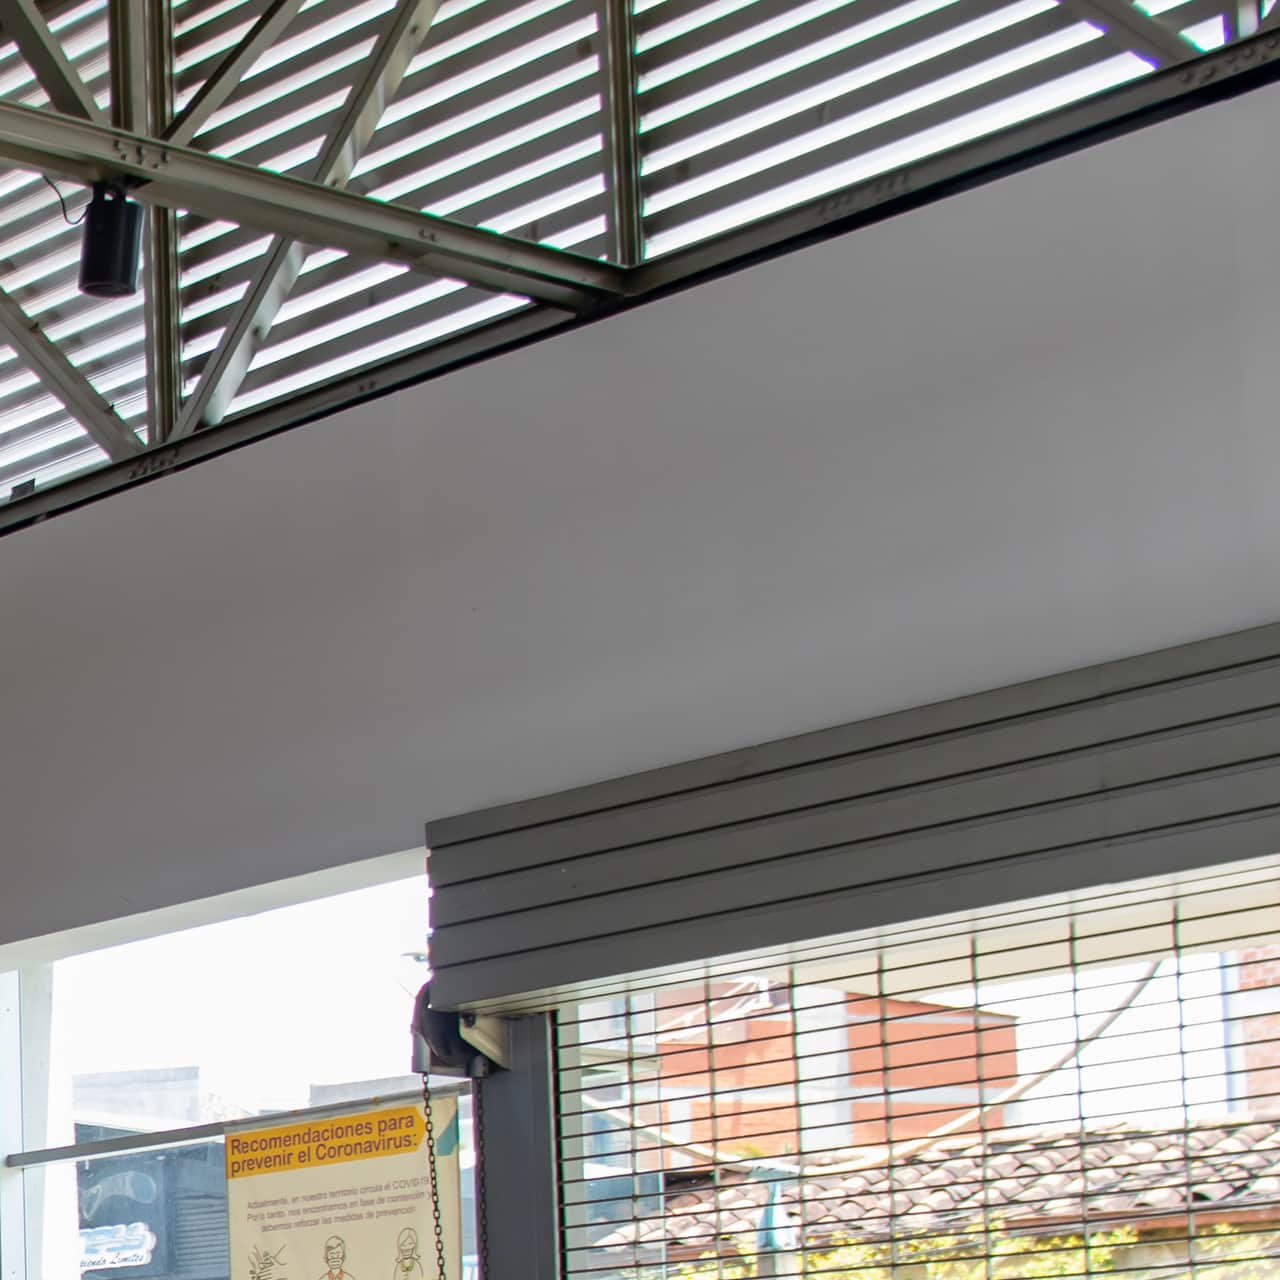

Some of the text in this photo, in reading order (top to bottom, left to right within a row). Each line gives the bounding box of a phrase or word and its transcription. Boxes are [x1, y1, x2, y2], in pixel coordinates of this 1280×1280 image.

[230, 1114, 414, 1156] Recomendaciones para
[231, 1133, 417, 1177] prevenir el Coronavirus:
